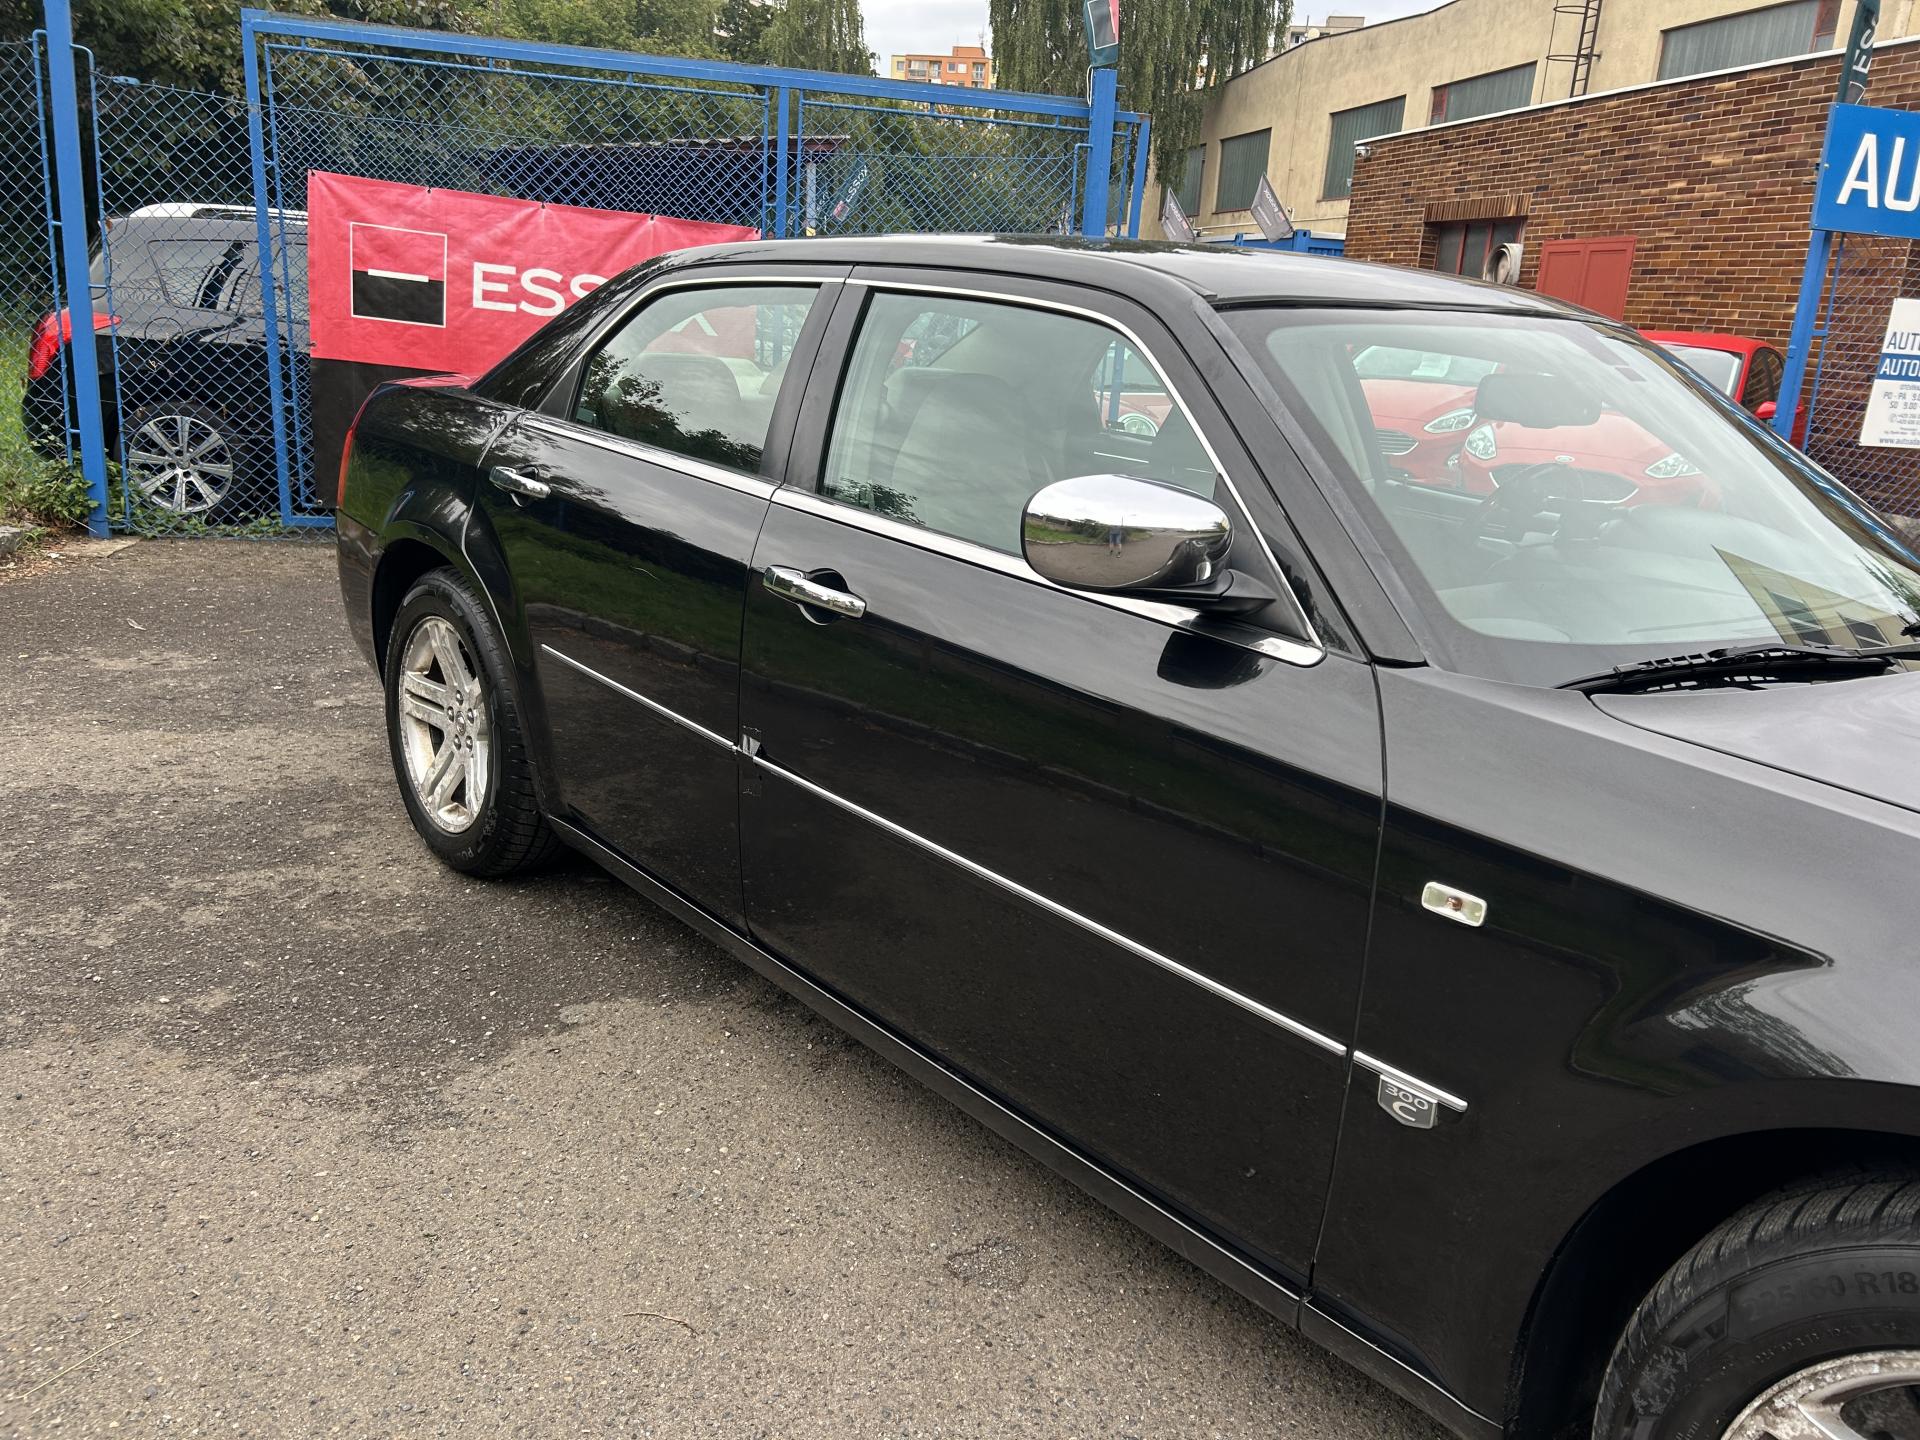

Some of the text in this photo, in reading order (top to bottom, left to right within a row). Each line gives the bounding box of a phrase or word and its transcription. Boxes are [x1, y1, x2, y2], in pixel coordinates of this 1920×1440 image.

[1886, 331, 1920, 351] AUT
[1880, 358, 1920, 377] AUTO
[1385, 1084, 1428, 1110] 300
[1393, 1101, 1416, 1121] C
